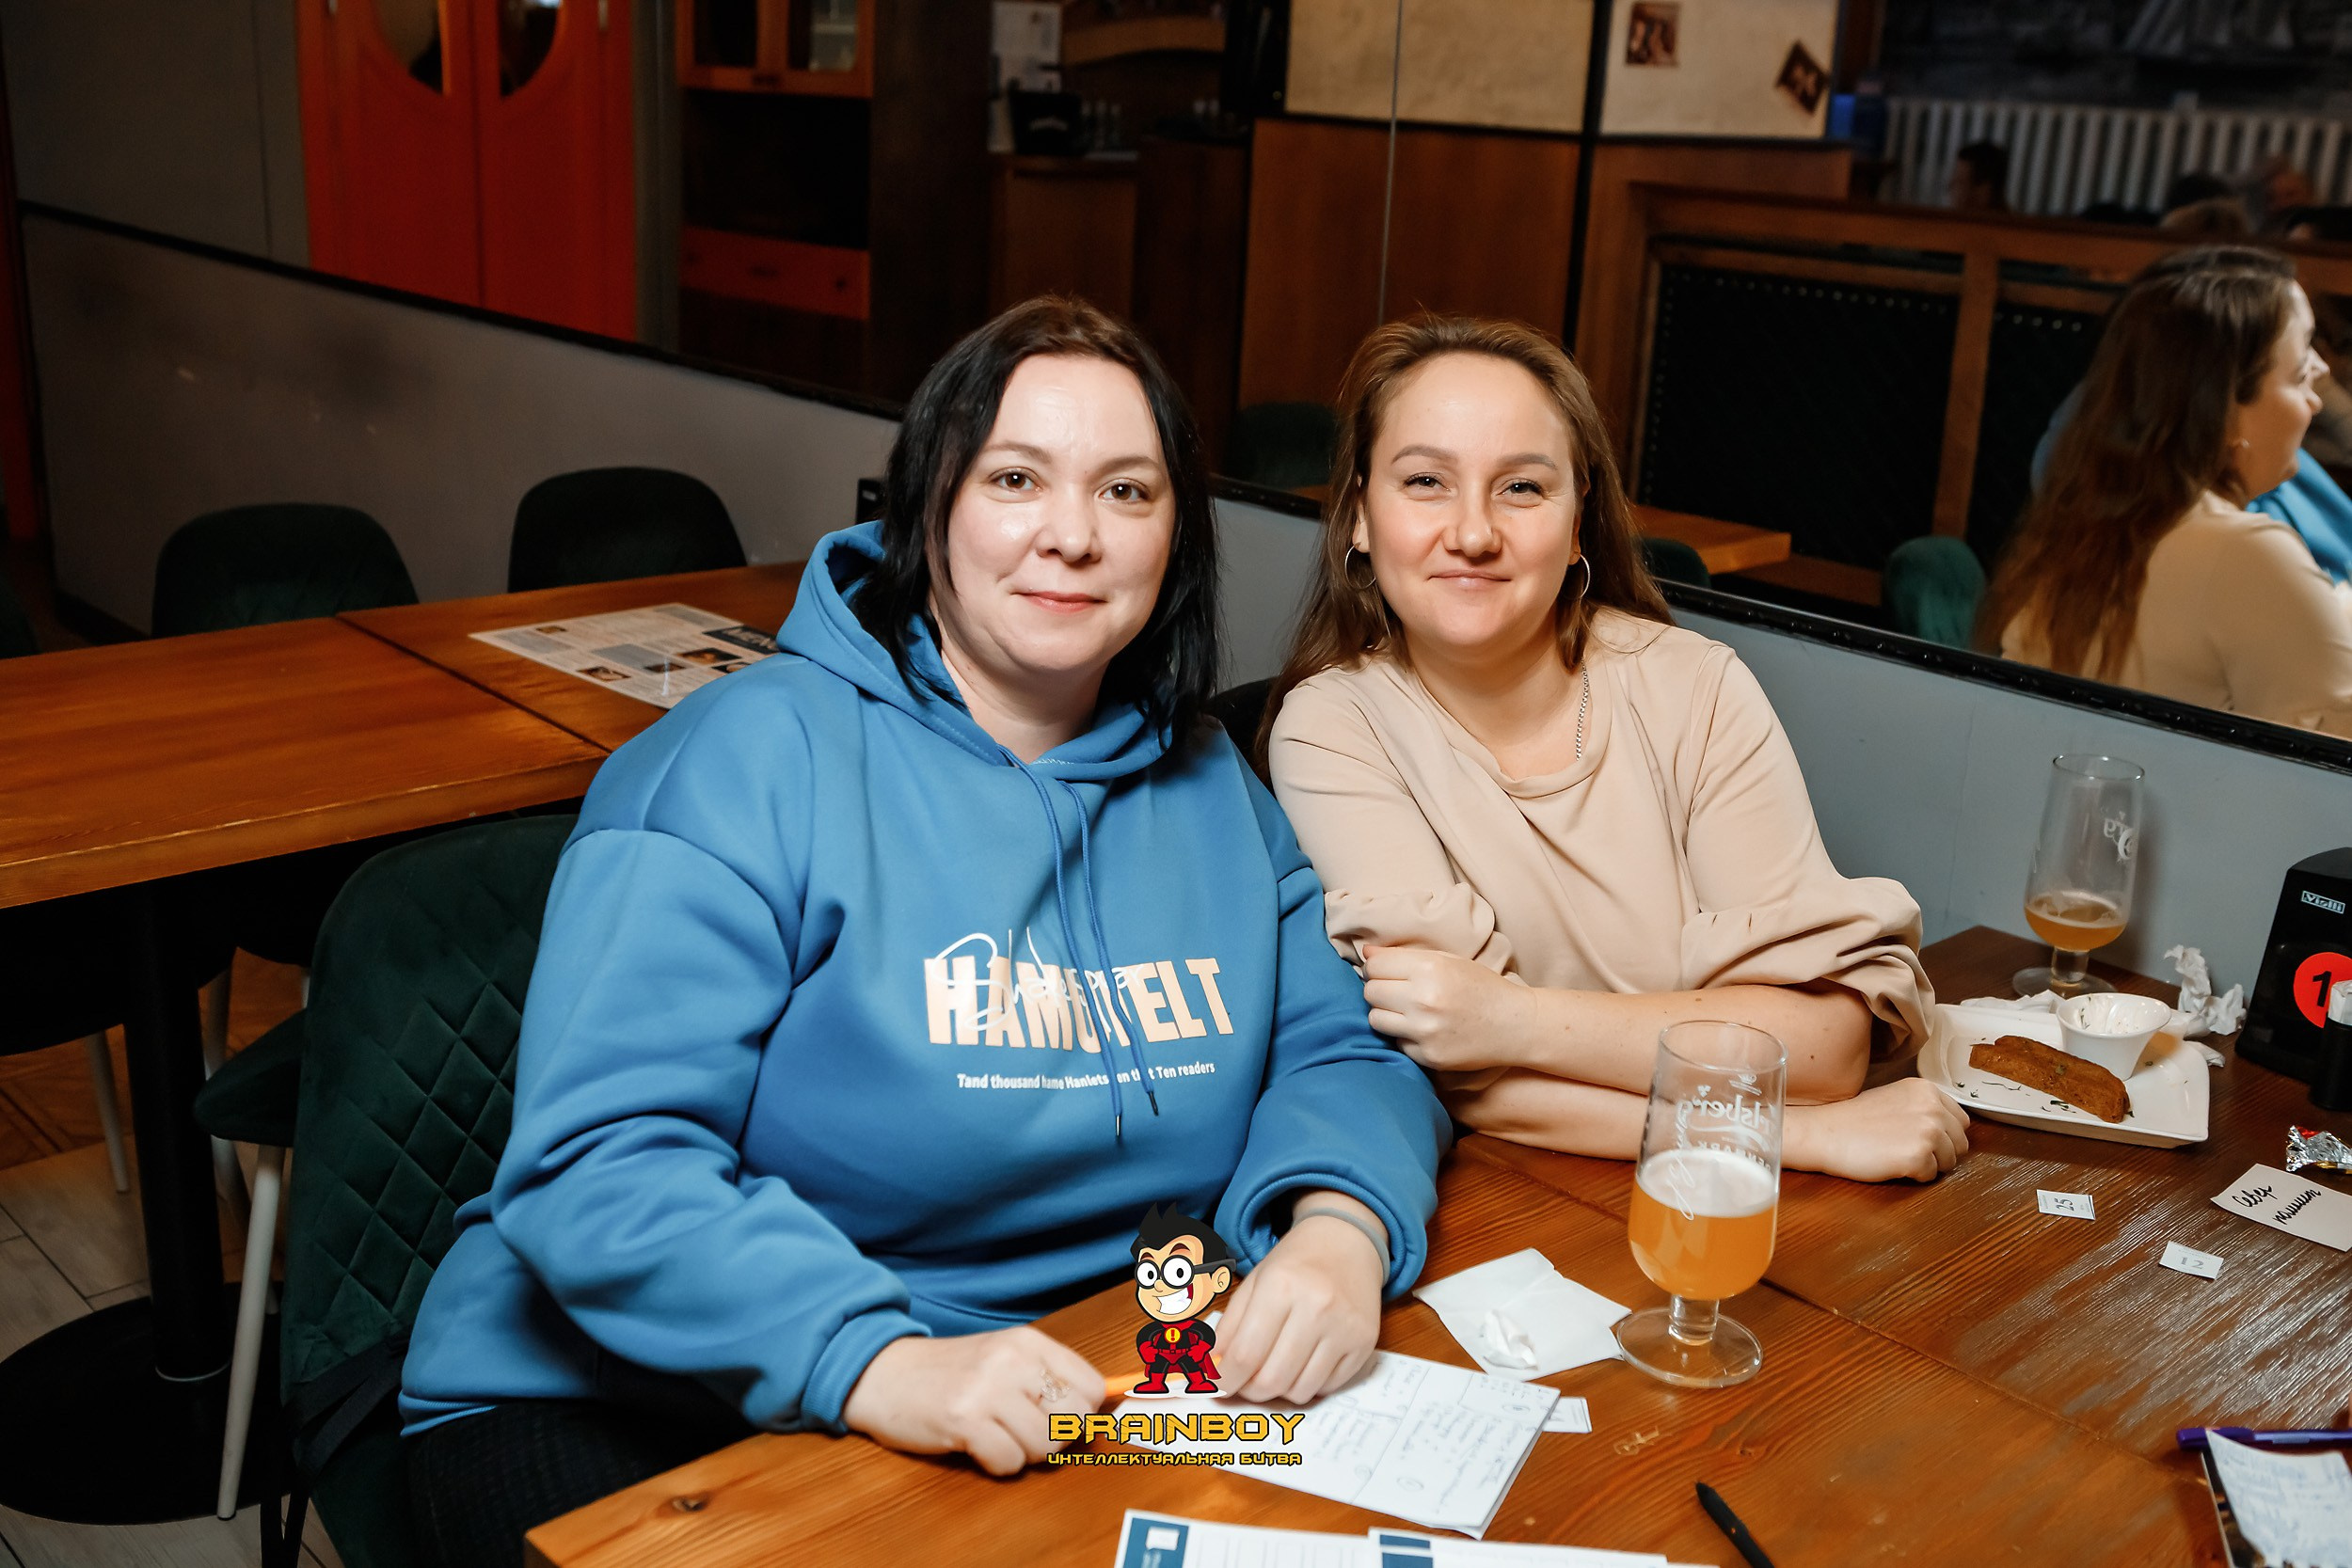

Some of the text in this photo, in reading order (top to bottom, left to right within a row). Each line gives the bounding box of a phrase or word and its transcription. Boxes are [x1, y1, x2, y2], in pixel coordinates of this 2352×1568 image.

[2312, 970, 2332, 1007] 1
[957, 1073, 989, 1088] Tand
[990, 1074, 1041, 1089] thousand
[1155, 1066, 1177, 1079] Ten
[1177, 1061, 1216, 1076] readers
[2181, 1257, 2204, 1270] 12
